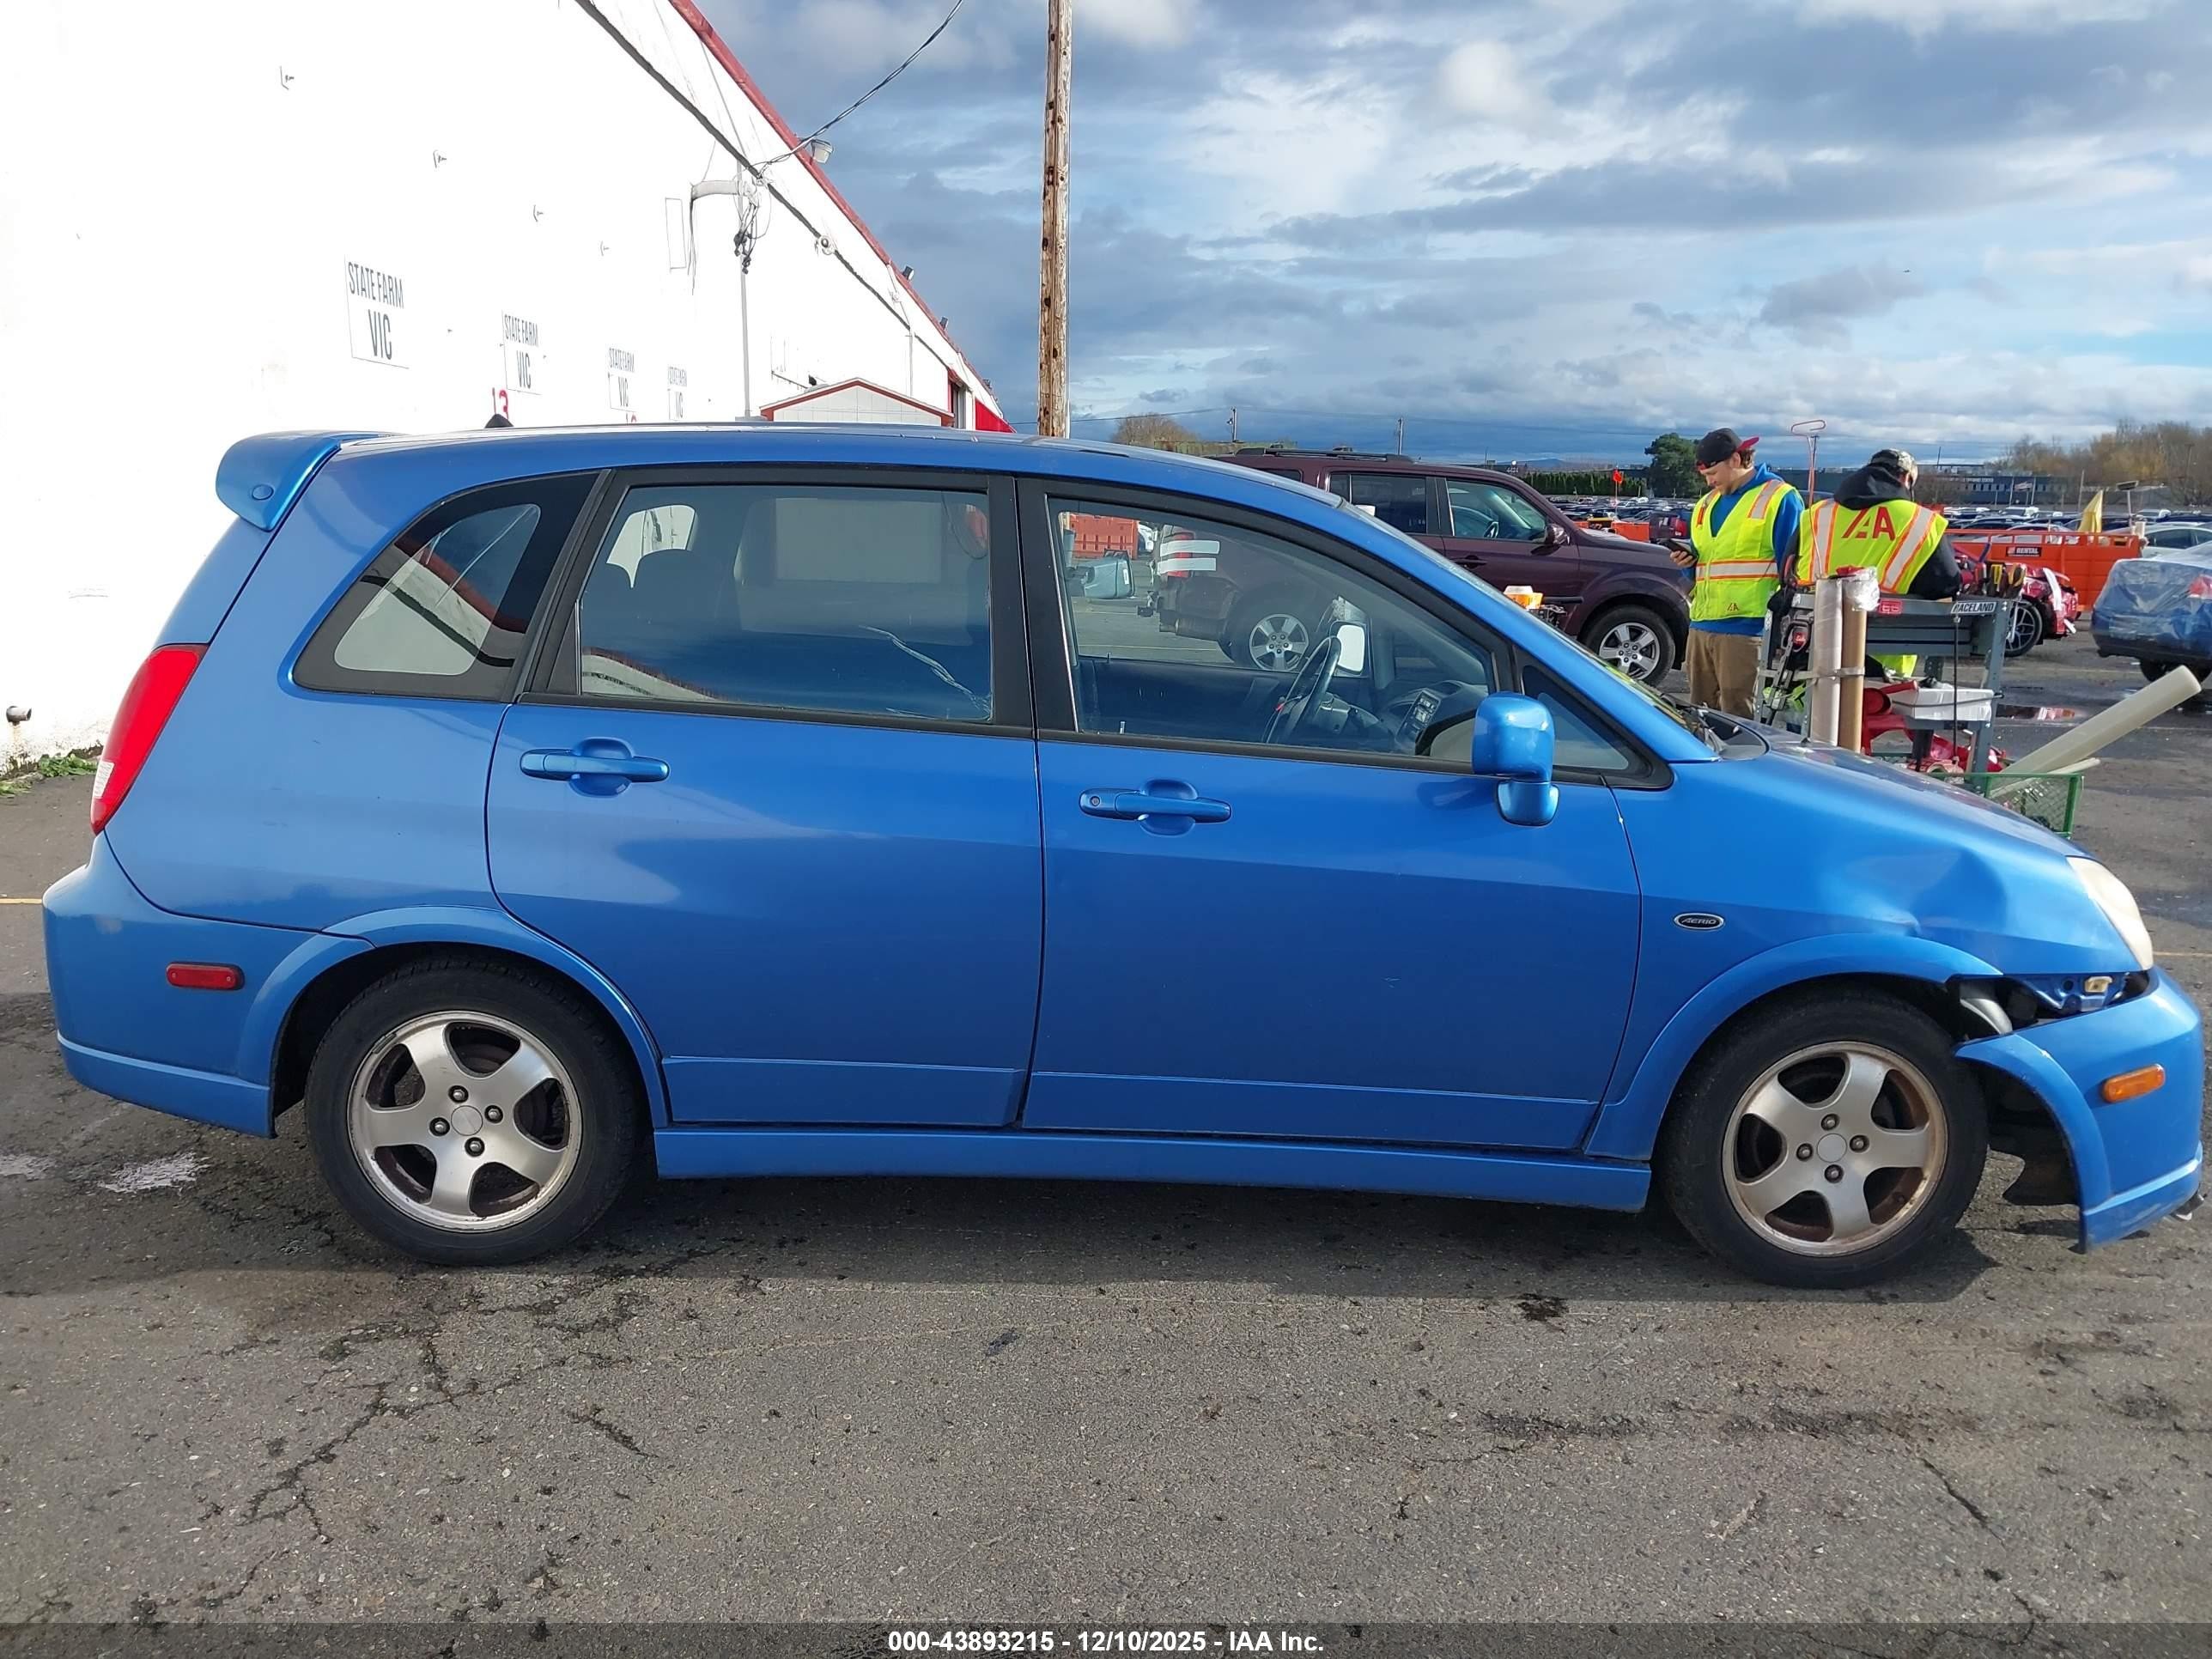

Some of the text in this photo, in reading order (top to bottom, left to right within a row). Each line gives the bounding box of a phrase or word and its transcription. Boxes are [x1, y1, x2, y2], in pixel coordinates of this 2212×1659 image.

[348, 261, 404, 309] STATE FARM
[368, 308, 392, 361] VIC
[504, 313, 538, 347] STATE FARM
[516, 349, 531, 389] VIC
[609, 347, 623, 370] STATE
[617, 375, 629, 407] VIC
[1952, 602, 1994, 613] RACELAND
